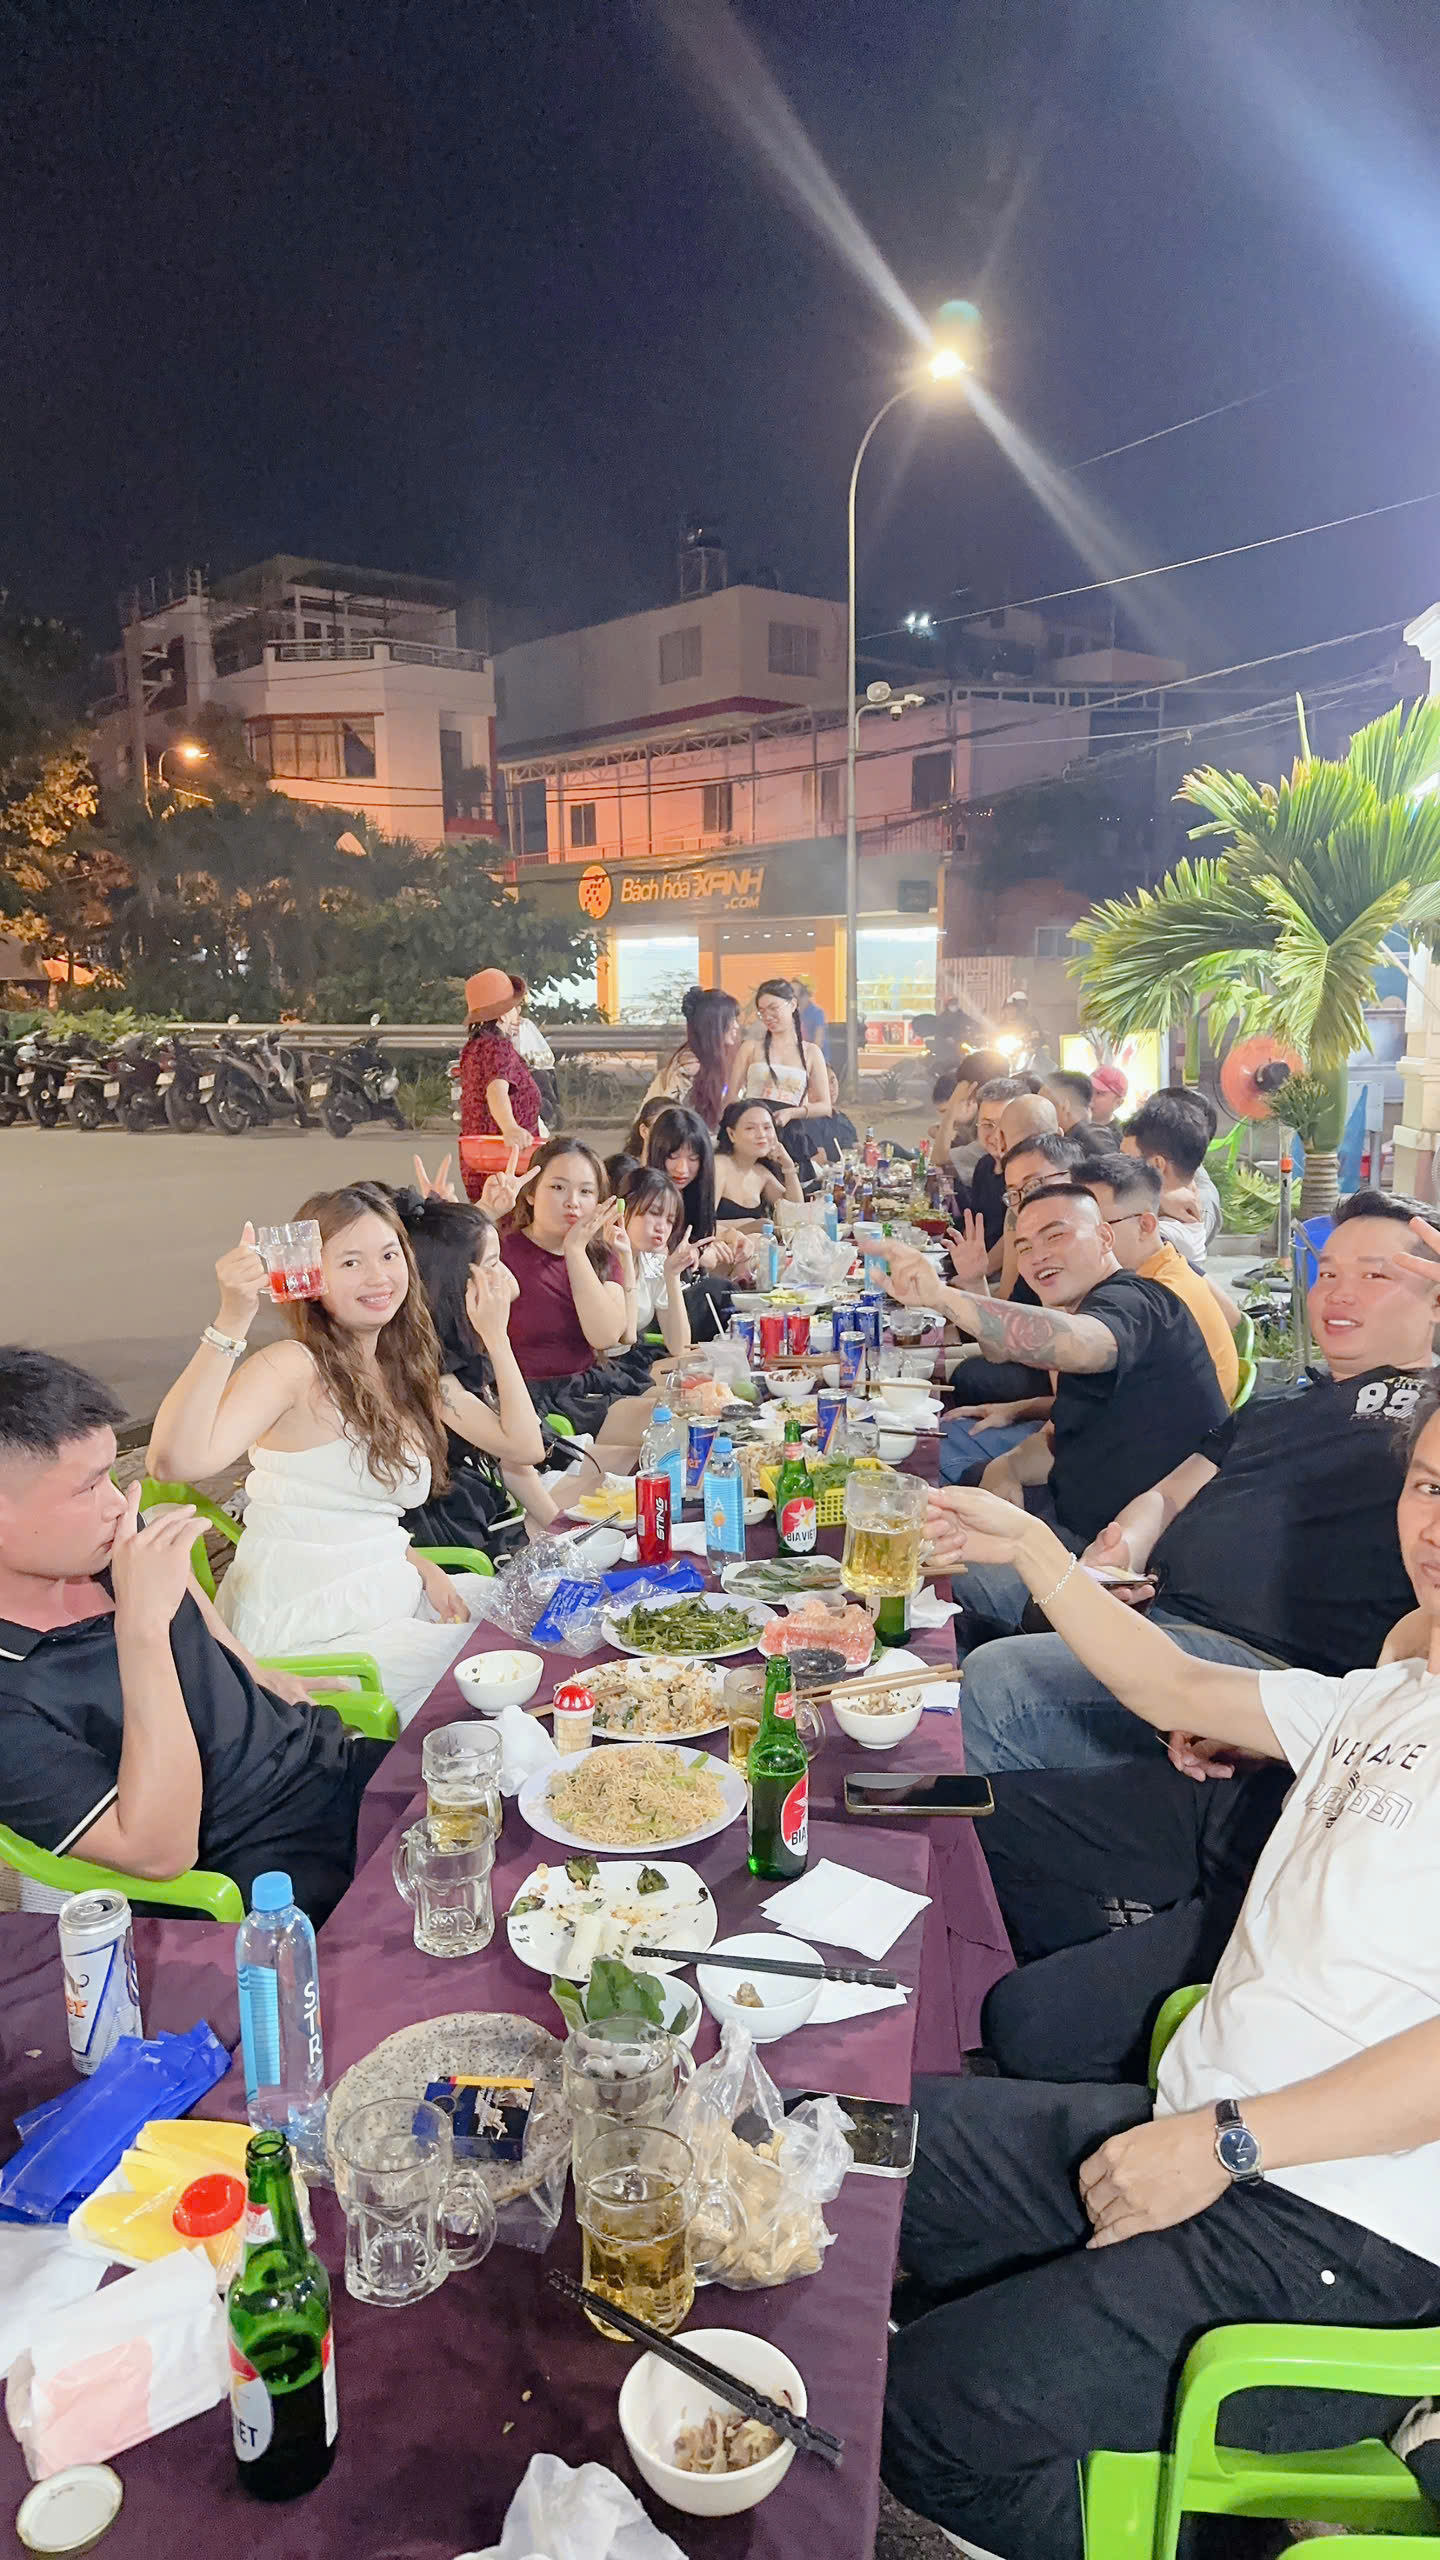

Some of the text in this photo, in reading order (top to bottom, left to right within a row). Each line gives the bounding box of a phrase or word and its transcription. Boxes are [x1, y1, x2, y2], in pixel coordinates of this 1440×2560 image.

[621, 867, 765, 902] Bách hóa XANH
[1355, 1382, 1420, 1419] 89
[655, 1496, 667, 1541] STING
[786, 1531, 801, 1542] BIA
